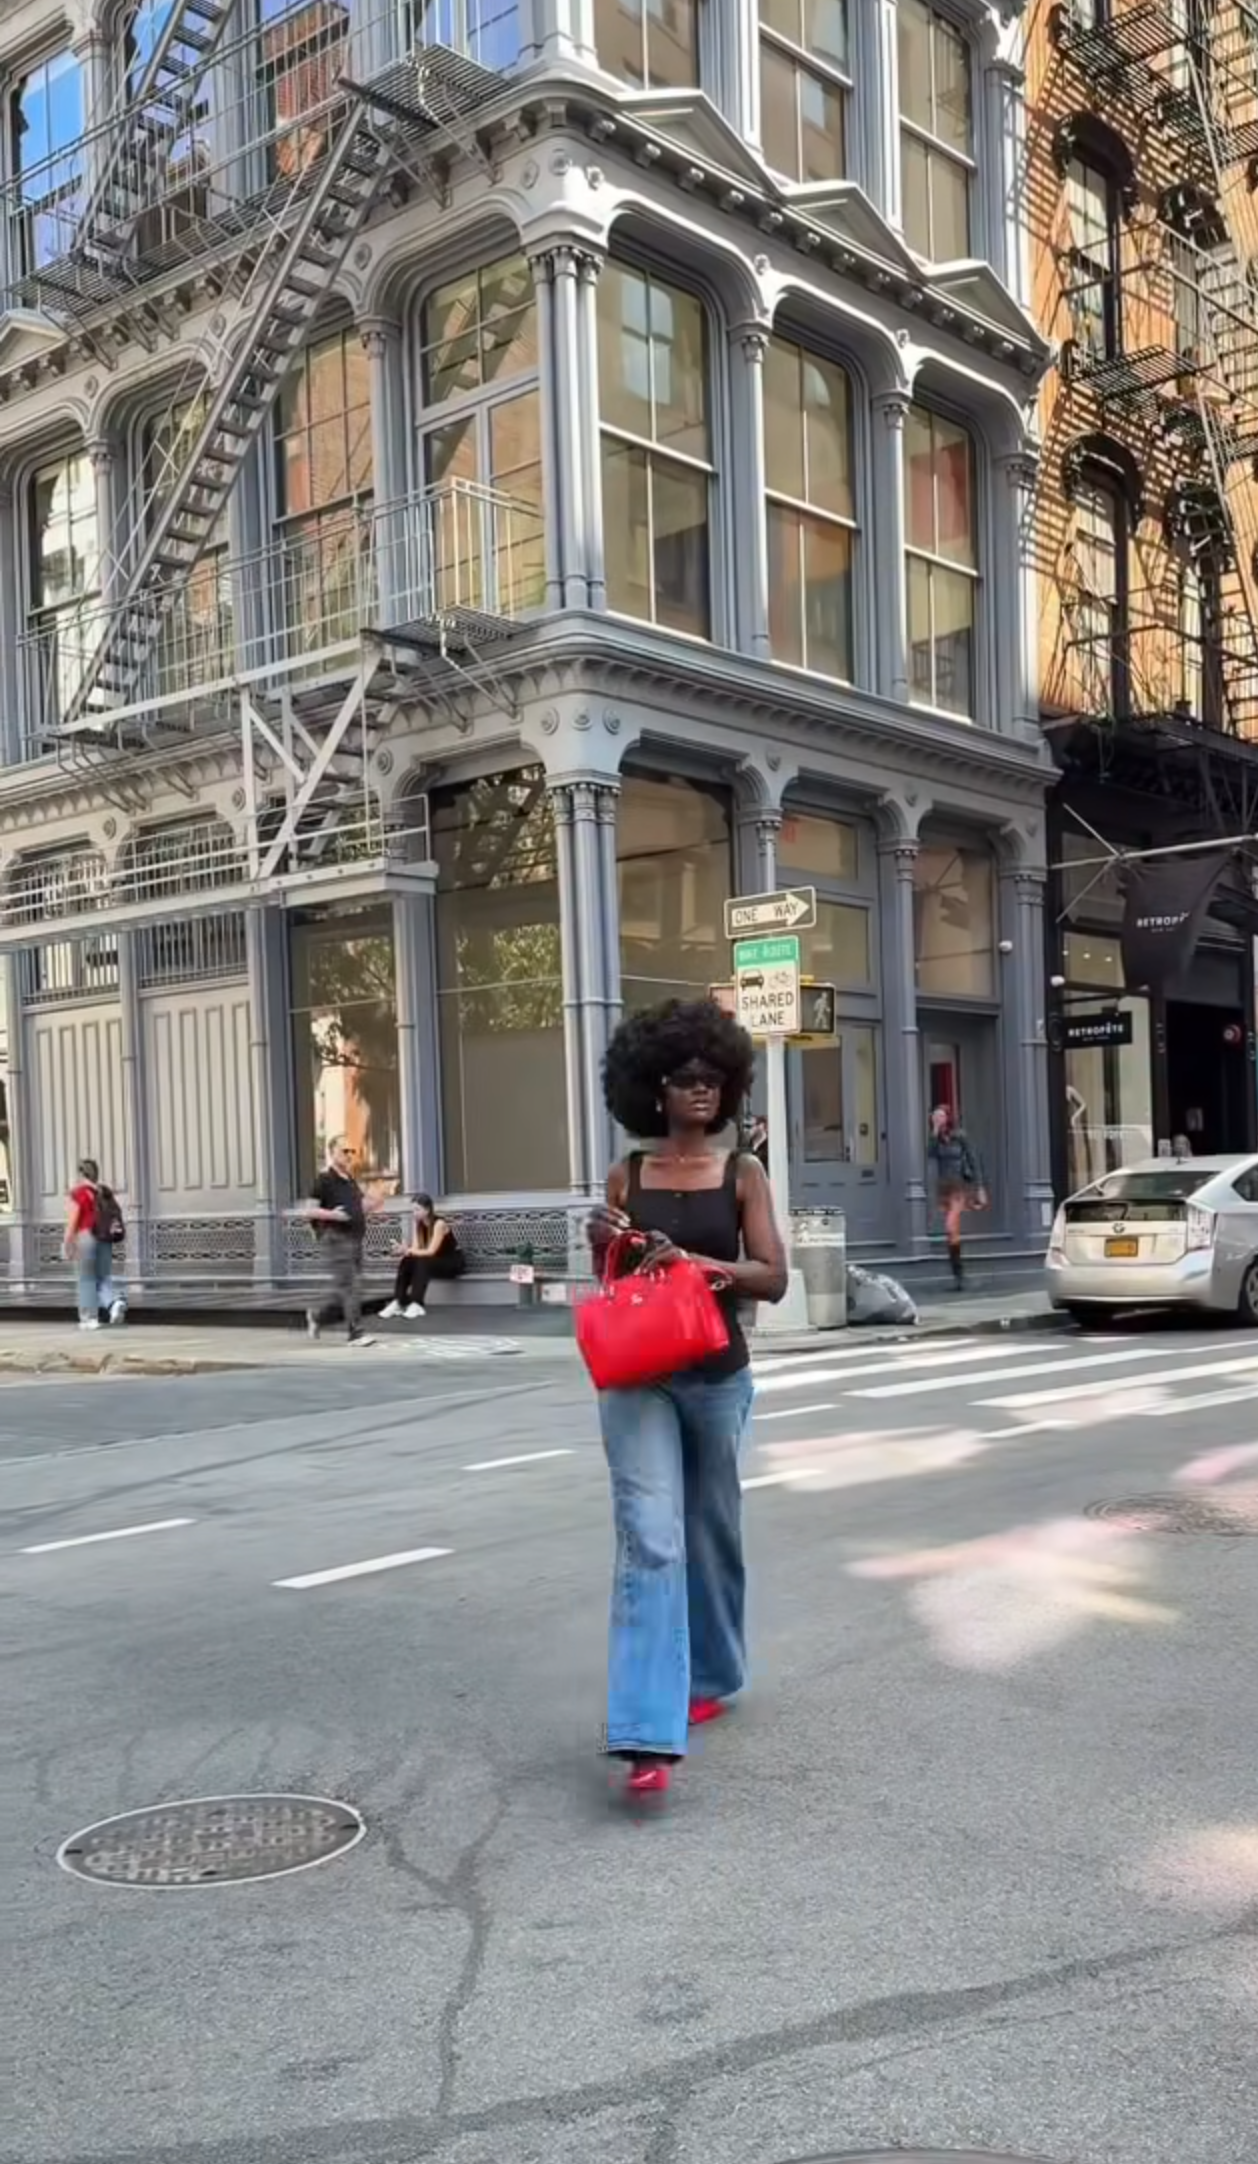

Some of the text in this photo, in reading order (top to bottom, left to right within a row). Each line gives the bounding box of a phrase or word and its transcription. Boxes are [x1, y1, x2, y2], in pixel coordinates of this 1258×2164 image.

[735, 901, 798, 924] ONE WAY
[742, 991, 794, 1010] SHARED
[751, 1010, 784, 1027] LANE
